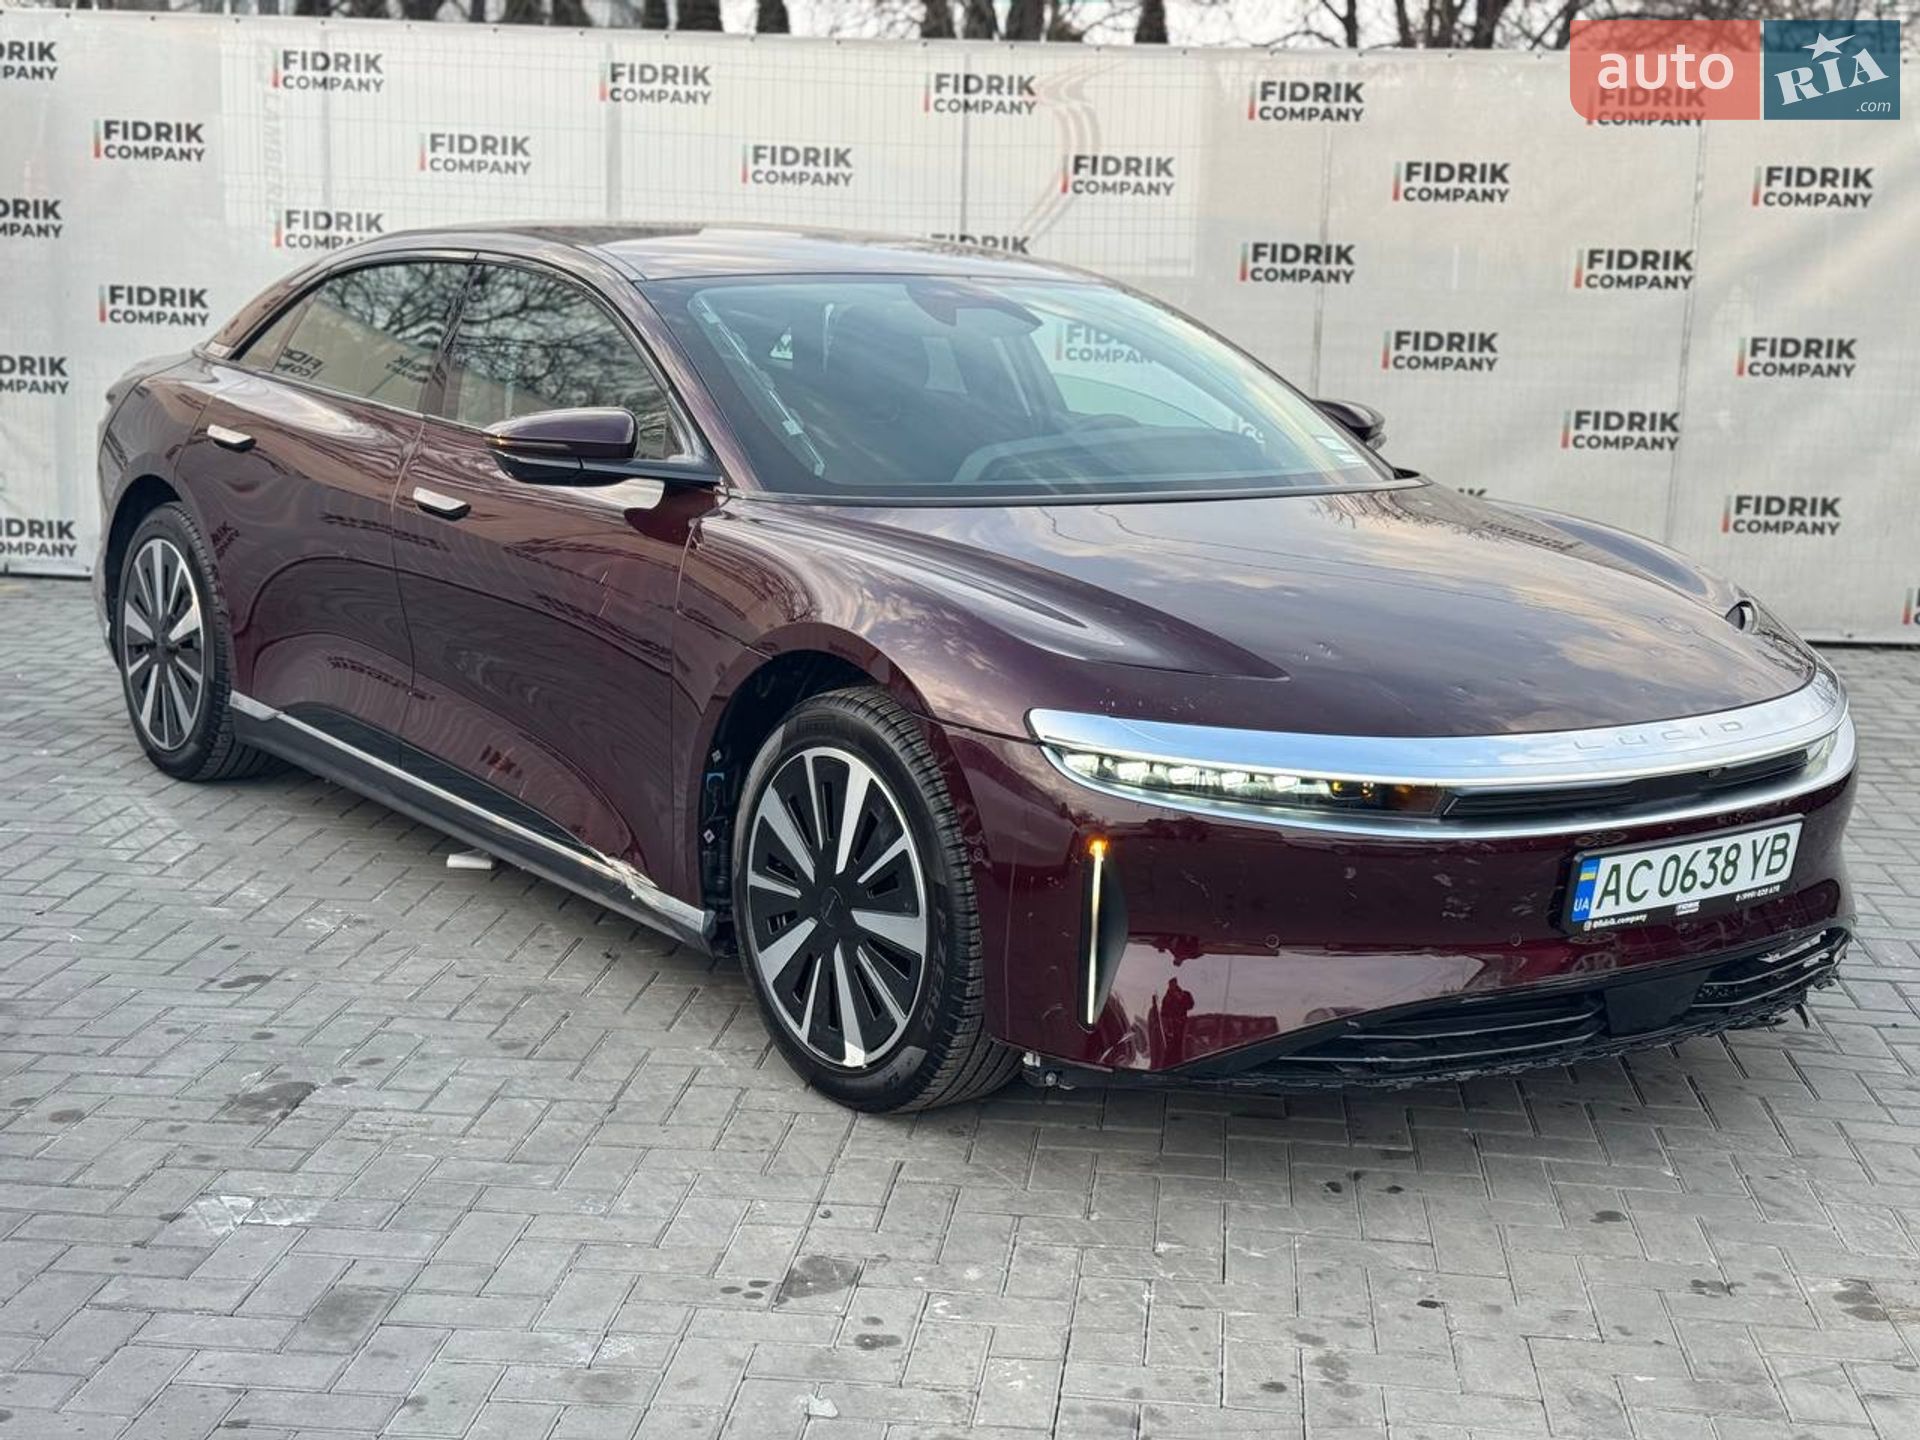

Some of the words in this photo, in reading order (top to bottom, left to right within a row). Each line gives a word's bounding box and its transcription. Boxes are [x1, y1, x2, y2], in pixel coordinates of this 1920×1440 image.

[0, 40, 56, 62] RIK
[282, 49, 383, 74] FIDRIK
[281, 74, 384, 93] COMPANY
[609, 61, 711, 86] FIDRIK
[608, 86, 711, 105] COMPANY
[935, 73, 1036, 97] FIDRIK
[1260, 81, 1364, 104] FIDRIK
[933, 98, 1037, 115] COMPANY
[1258, 106, 1364, 122] COMPANY
[1597, 109, 1706, 126] COMPANY
[103, 120, 204, 144] FIDRIK
[103, 144, 205, 162] COMPANY
[429, 132, 530, 157] FIDRIK
[429, 157, 532, 175] COMPANY
[752, 144, 852, 169] FIDRIK
[1072, 154, 1174, 178] FIDRIK
[751, 169, 853, 187] COMPANY
[1405, 161, 1509, 184] FIDRIK
[1765, 166, 1873, 189] FIDRIK
[1071, 179, 1174, 196] COMPANY
[1403, 186, 1509, 203] COMPANY
[1763, 191, 1873, 208] COMPANY
[285, 210, 383, 233] FIDRIK
[1252, 242, 1355, 266] FIDRIK
[1587, 249, 1693, 272] FIDRIK
[1250, 267, 1354, 284] COMPANY
[1585, 274, 1694, 290] COMPANY
[109, 284, 208, 309] FIDRIK
[108, 308, 209, 327] COMPANY
[1394, 330, 1497, 354] FIDRIK
[1750, 337, 1856, 360] FIDRIK
[0, 354, 67, 377] DRIK
[1066, 347, 1152, 363] COMPA
[1392, 355, 1498, 372] COMPANY
[1747, 361, 1856, 378] COMPANY
[1574, 410, 1680, 433] FIDRIK
[1572, 434, 1679, 452] COMPANY
[1735, 495, 1840, 518] FIDRIK
[1732, 519, 1840, 536] COMPANY
[1573, 720, 1743, 750] LUCID
[1595, 859, 1654, 910] AC
[1657, 842, 1742, 898] 0638
[1750, 832, 1791, 881] YB
[1573, 896, 1590, 913] UA
